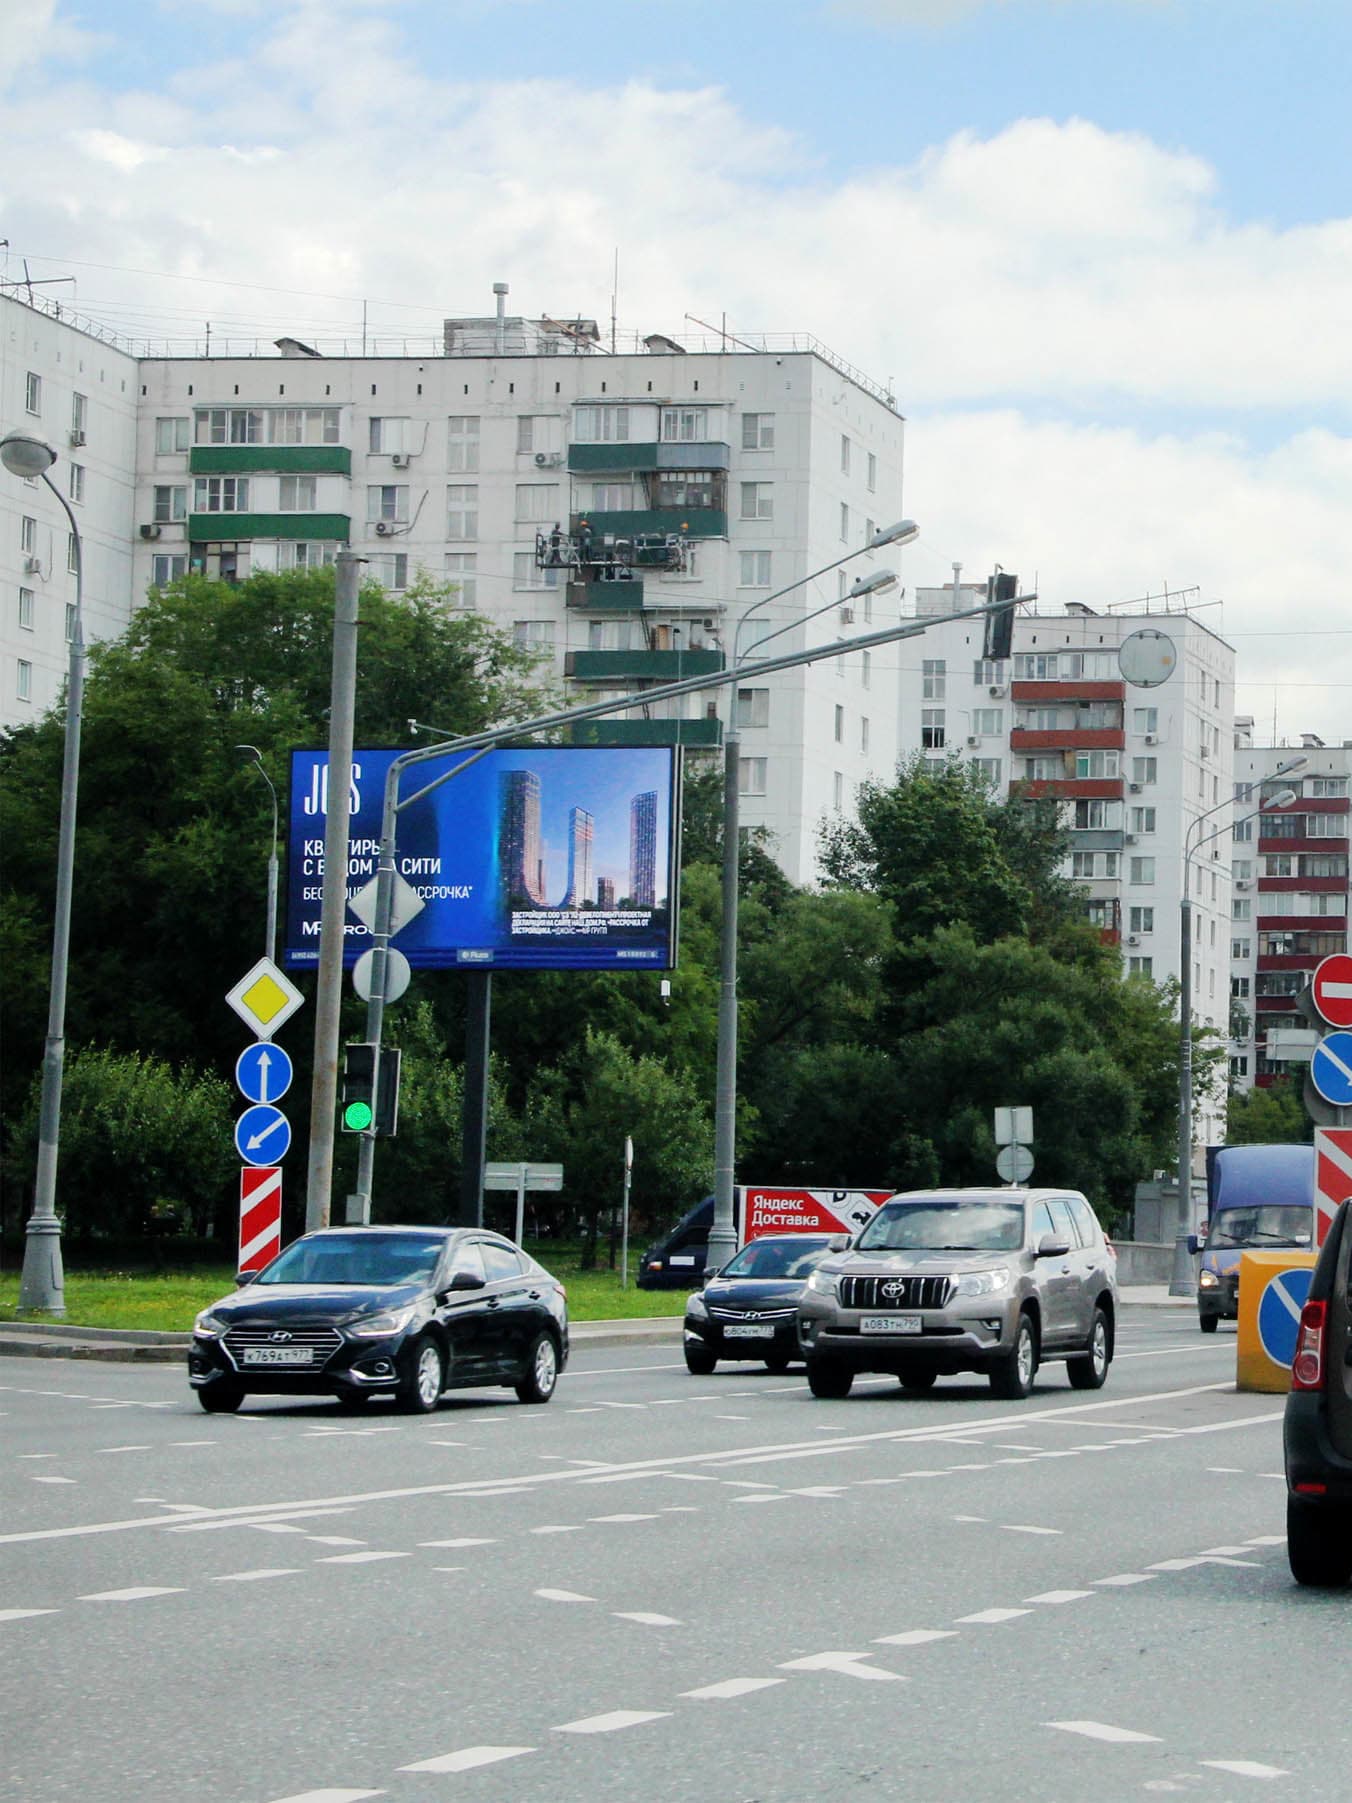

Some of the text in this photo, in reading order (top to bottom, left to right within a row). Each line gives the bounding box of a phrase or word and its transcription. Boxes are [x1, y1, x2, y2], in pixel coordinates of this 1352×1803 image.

[401, 858, 441, 875] СИТИ
[753, 1195, 805, 1211] Яндекс
[751, 1210, 819, 1227] Доставка
